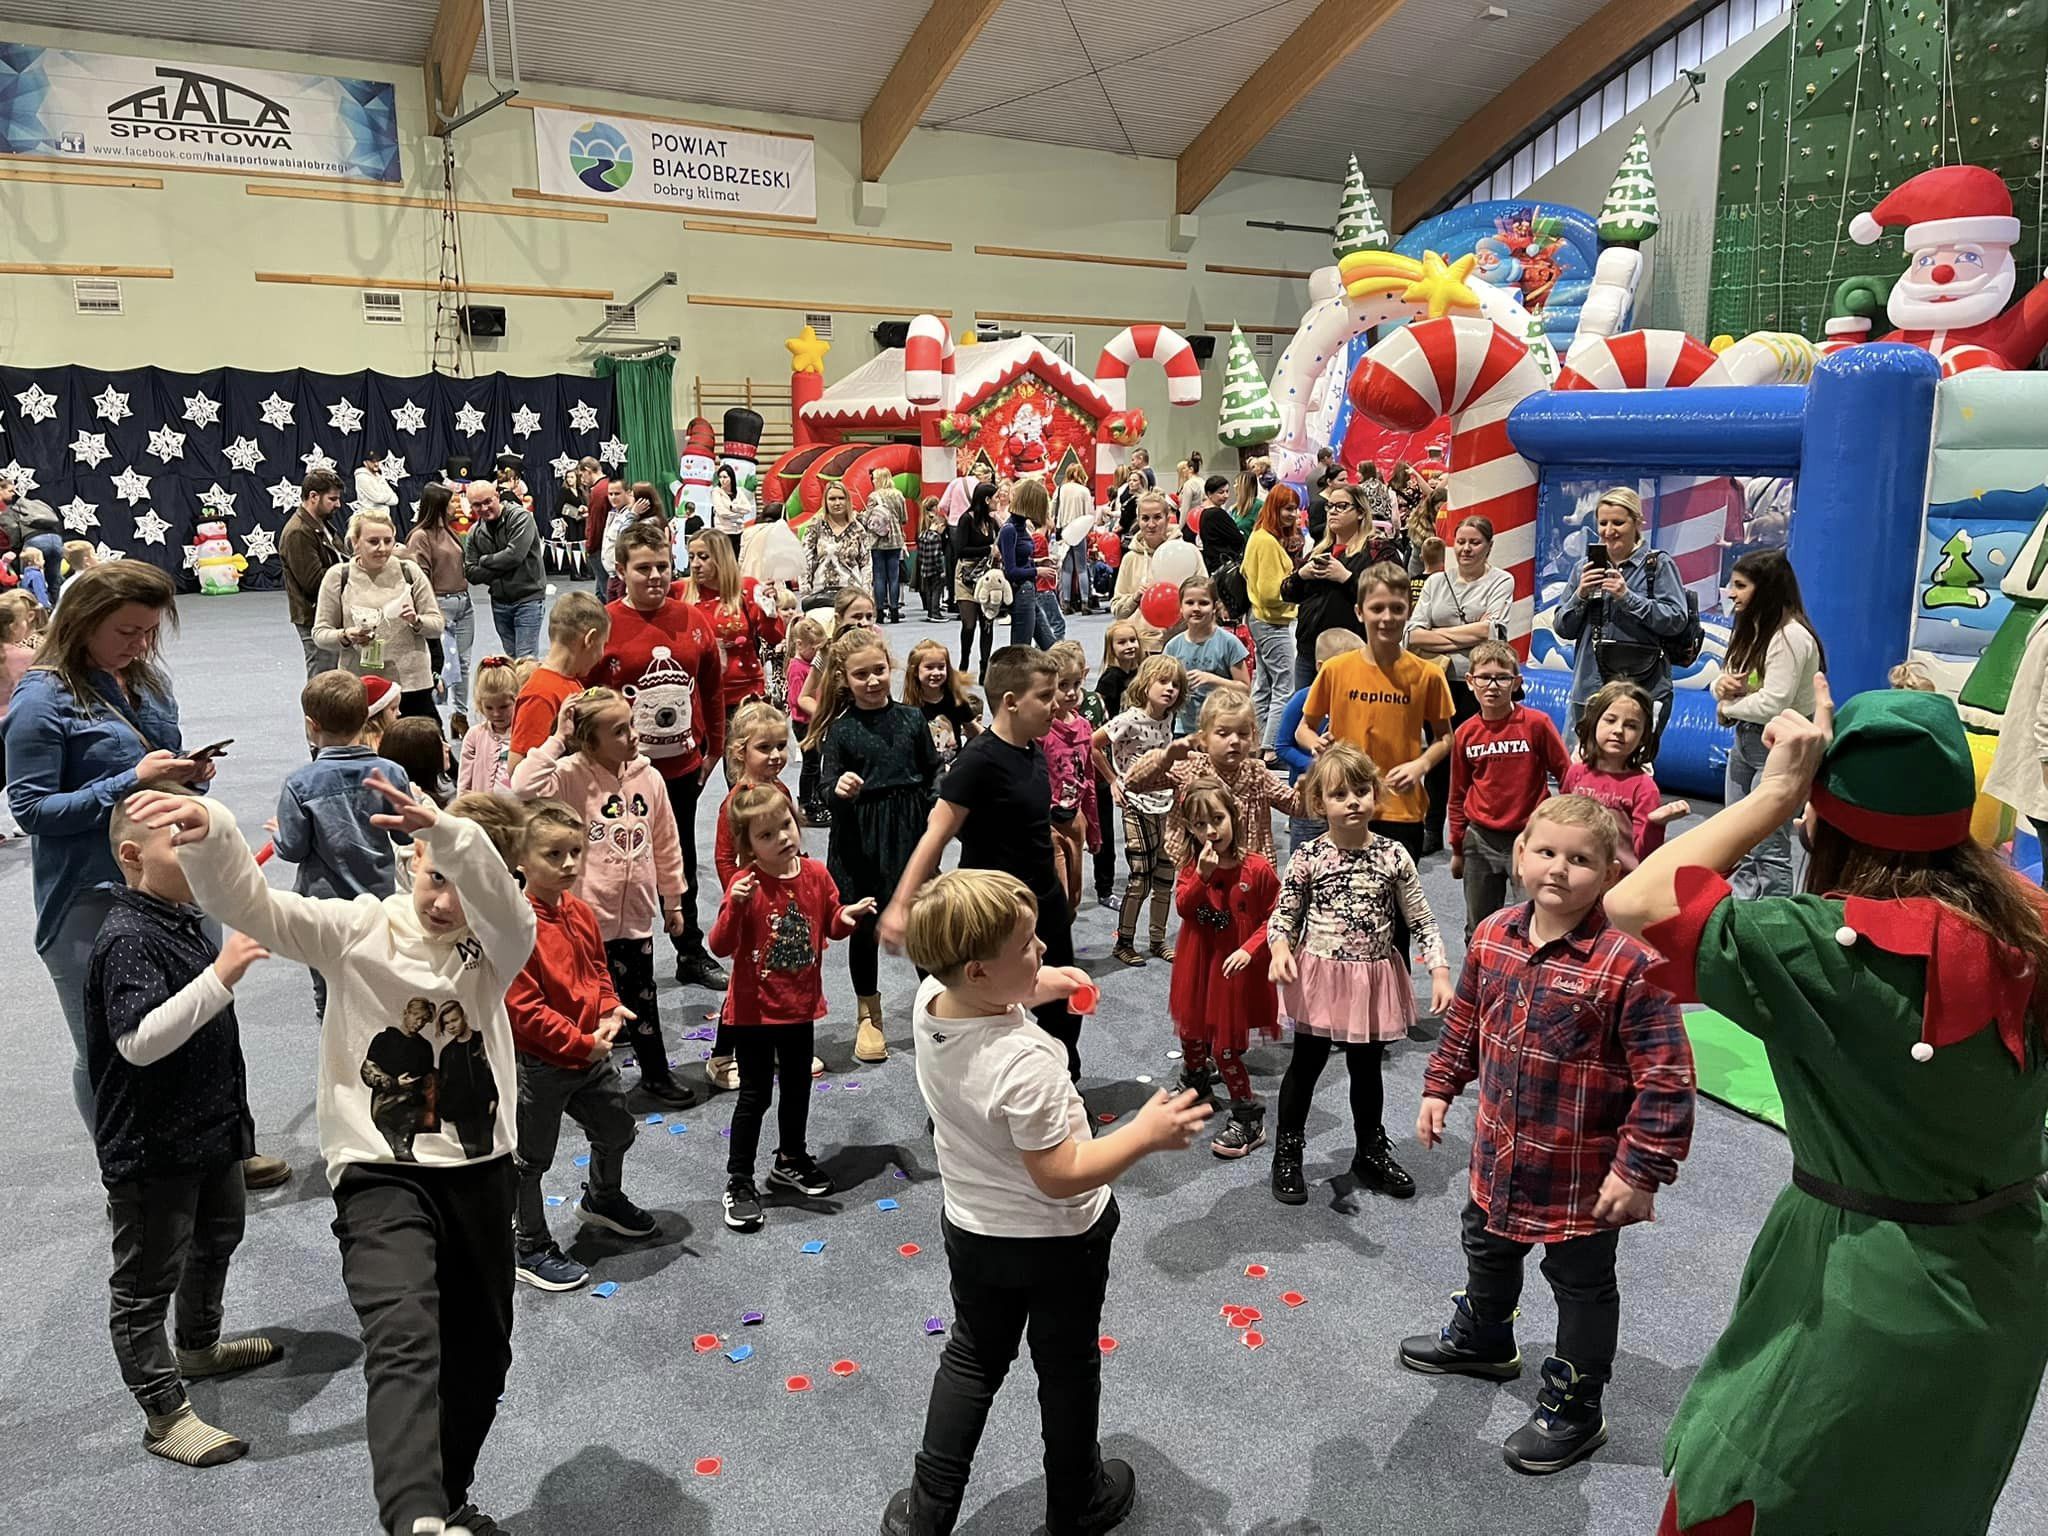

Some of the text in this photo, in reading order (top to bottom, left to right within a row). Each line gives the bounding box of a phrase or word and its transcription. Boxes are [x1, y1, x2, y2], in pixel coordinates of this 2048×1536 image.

[107, 66, 289, 129] HALA
[110, 122, 292, 150] SPORTOWA
[651, 133, 728, 158] POWIAT
[652, 158, 791, 189] BIAŁOBRZESKI
[653, 183, 740, 202] Dobry klimat
[1465, 739, 1531, 758] ATLANTA
